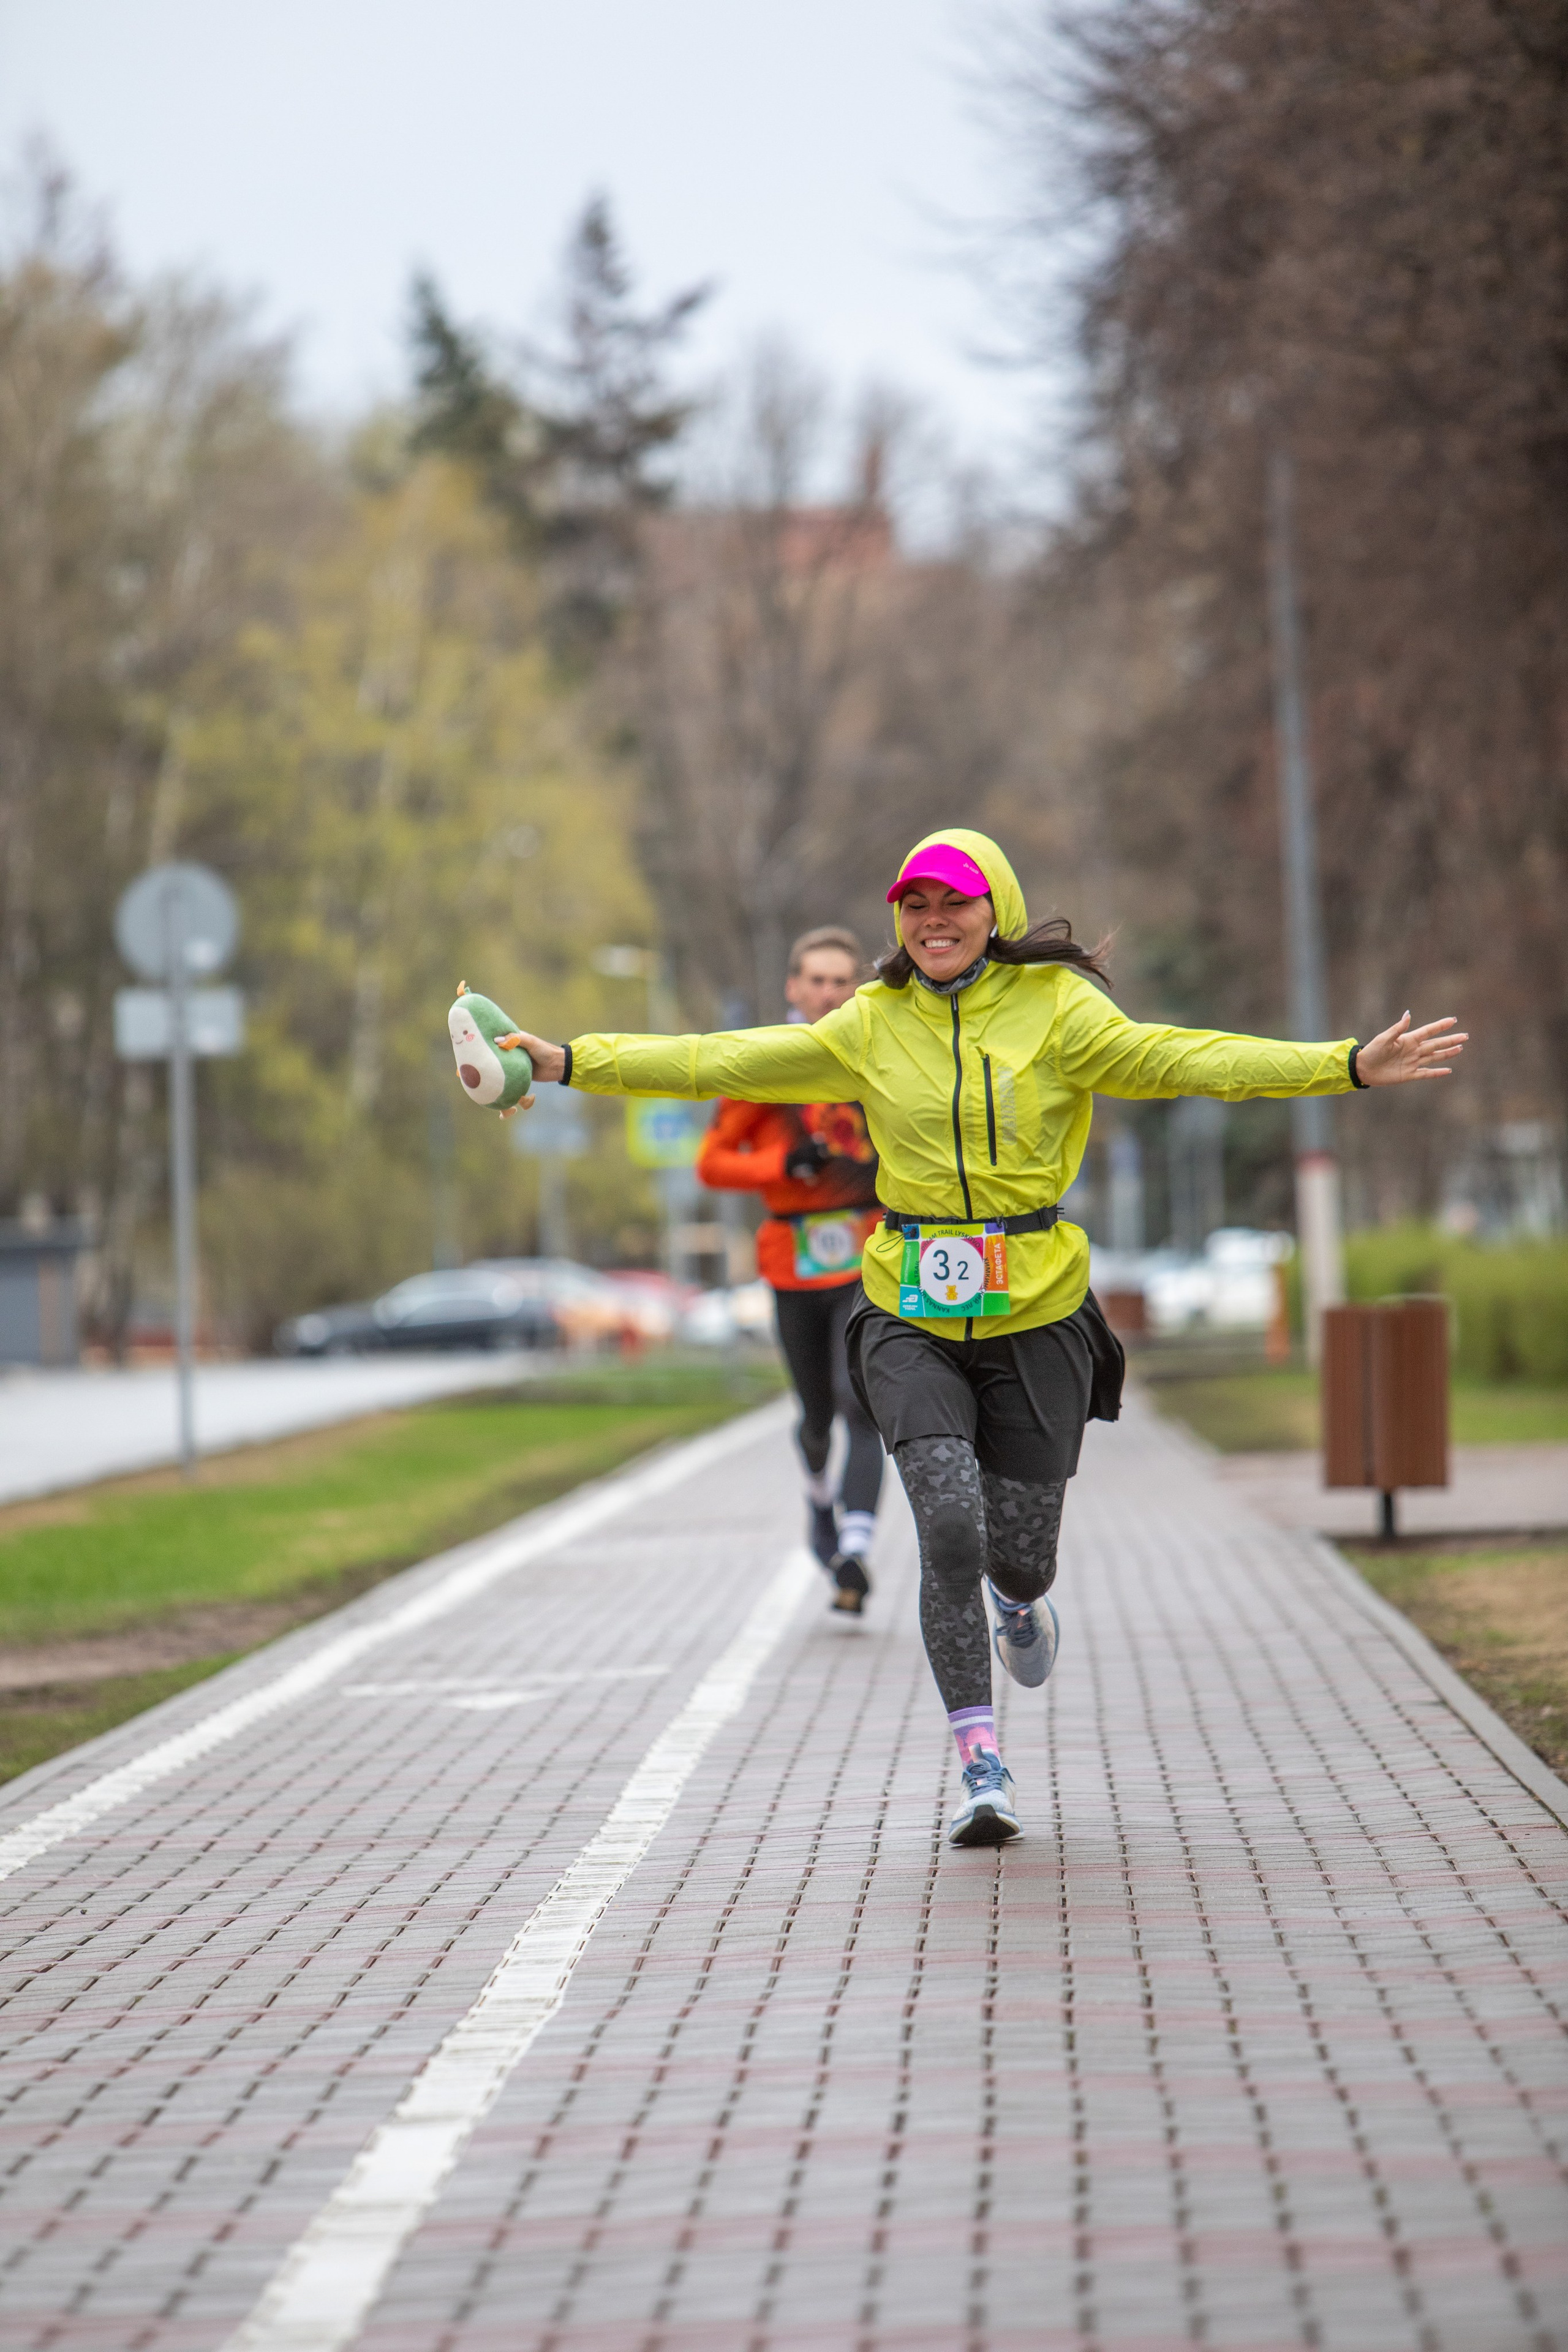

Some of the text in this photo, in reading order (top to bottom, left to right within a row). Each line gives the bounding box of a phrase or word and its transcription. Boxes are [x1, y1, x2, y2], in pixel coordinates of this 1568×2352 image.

[921, 1233, 937, 1251] DREAM
[955, 1230, 981, 1248] LYSKOVO
[993, 1243, 1003, 1285] ЭСТАФЕТА
[960, 1257, 991, 1311] ХИМКИНСКИЙ ЛЕС
[925, 1298, 950, 1313] KANNAS
